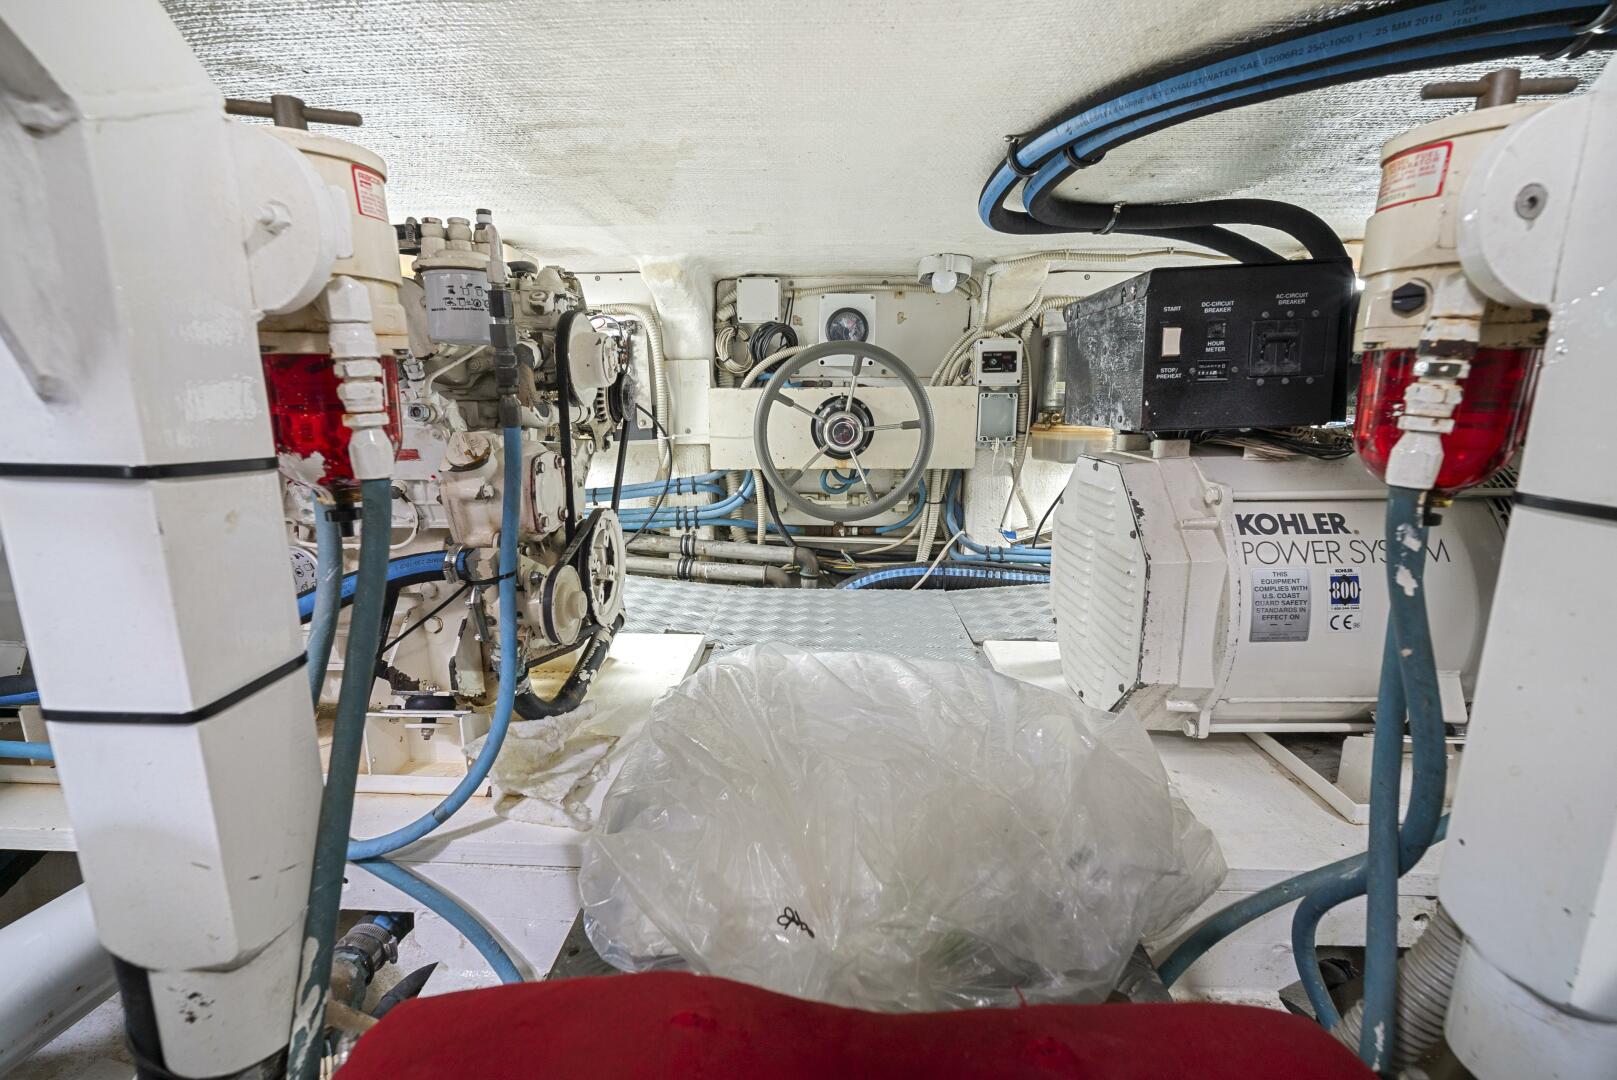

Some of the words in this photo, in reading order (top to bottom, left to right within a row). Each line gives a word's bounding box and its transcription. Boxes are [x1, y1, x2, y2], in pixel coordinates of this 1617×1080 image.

[1240, 61, 1259, 72] SAE
[1415, 14, 1443, 27] 2010
[1241, 540, 1344, 565] POWER
[1349, 539, 1451, 564] SYSM
[1332, 581, 1359, 599] 800
